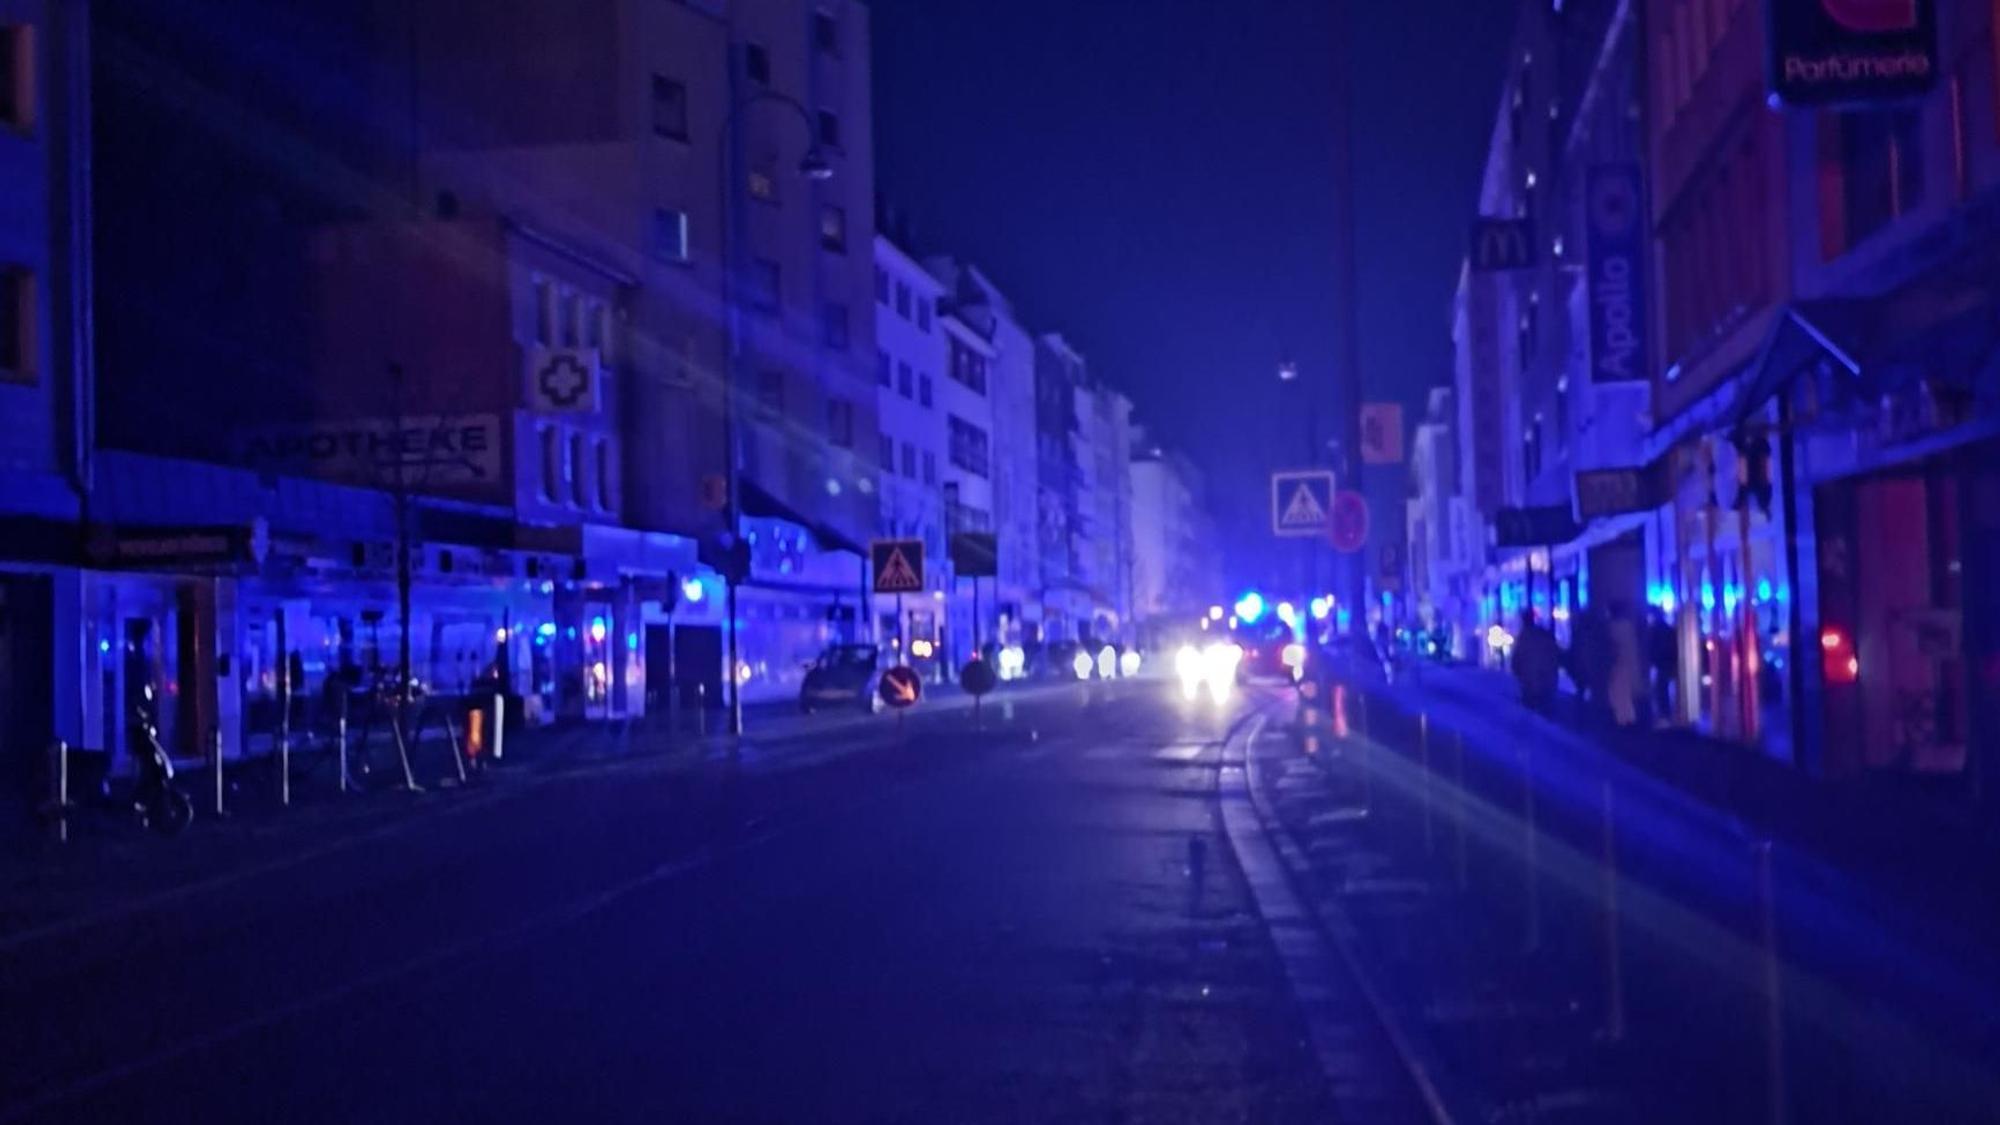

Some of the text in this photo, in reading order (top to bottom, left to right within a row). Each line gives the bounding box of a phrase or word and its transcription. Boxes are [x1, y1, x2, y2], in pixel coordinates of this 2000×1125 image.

[1783, 51, 1930, 82] Parfümerie
[1596, 255, 1640, 376] Apollo
[245, 426, 487, 459] APOTHEKE
